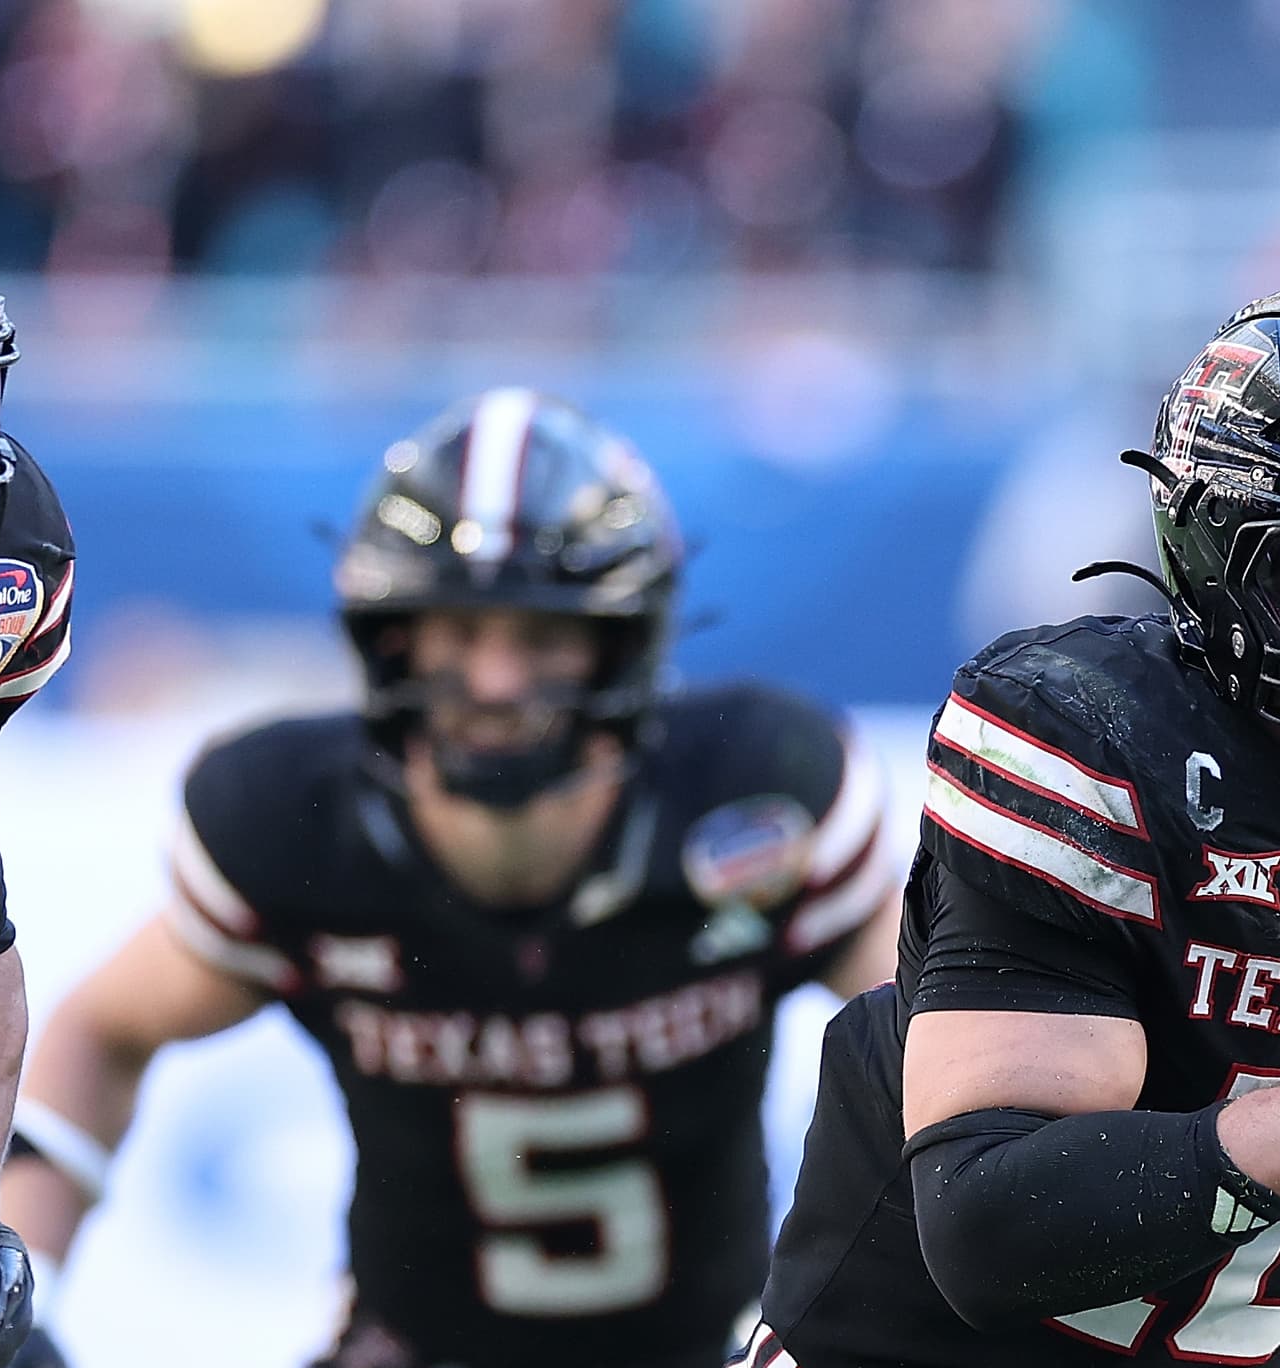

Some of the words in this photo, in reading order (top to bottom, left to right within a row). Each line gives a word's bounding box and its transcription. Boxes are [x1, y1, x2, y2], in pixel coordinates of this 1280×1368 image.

[0, 614, 26, 637] BOWL
[1184, 752, 1224, 831] C
[336, 1000, 573, 1084] TEXAS
[577, 974, 764, 1076] TECH
[455, 1086, 671, 1316] 5
